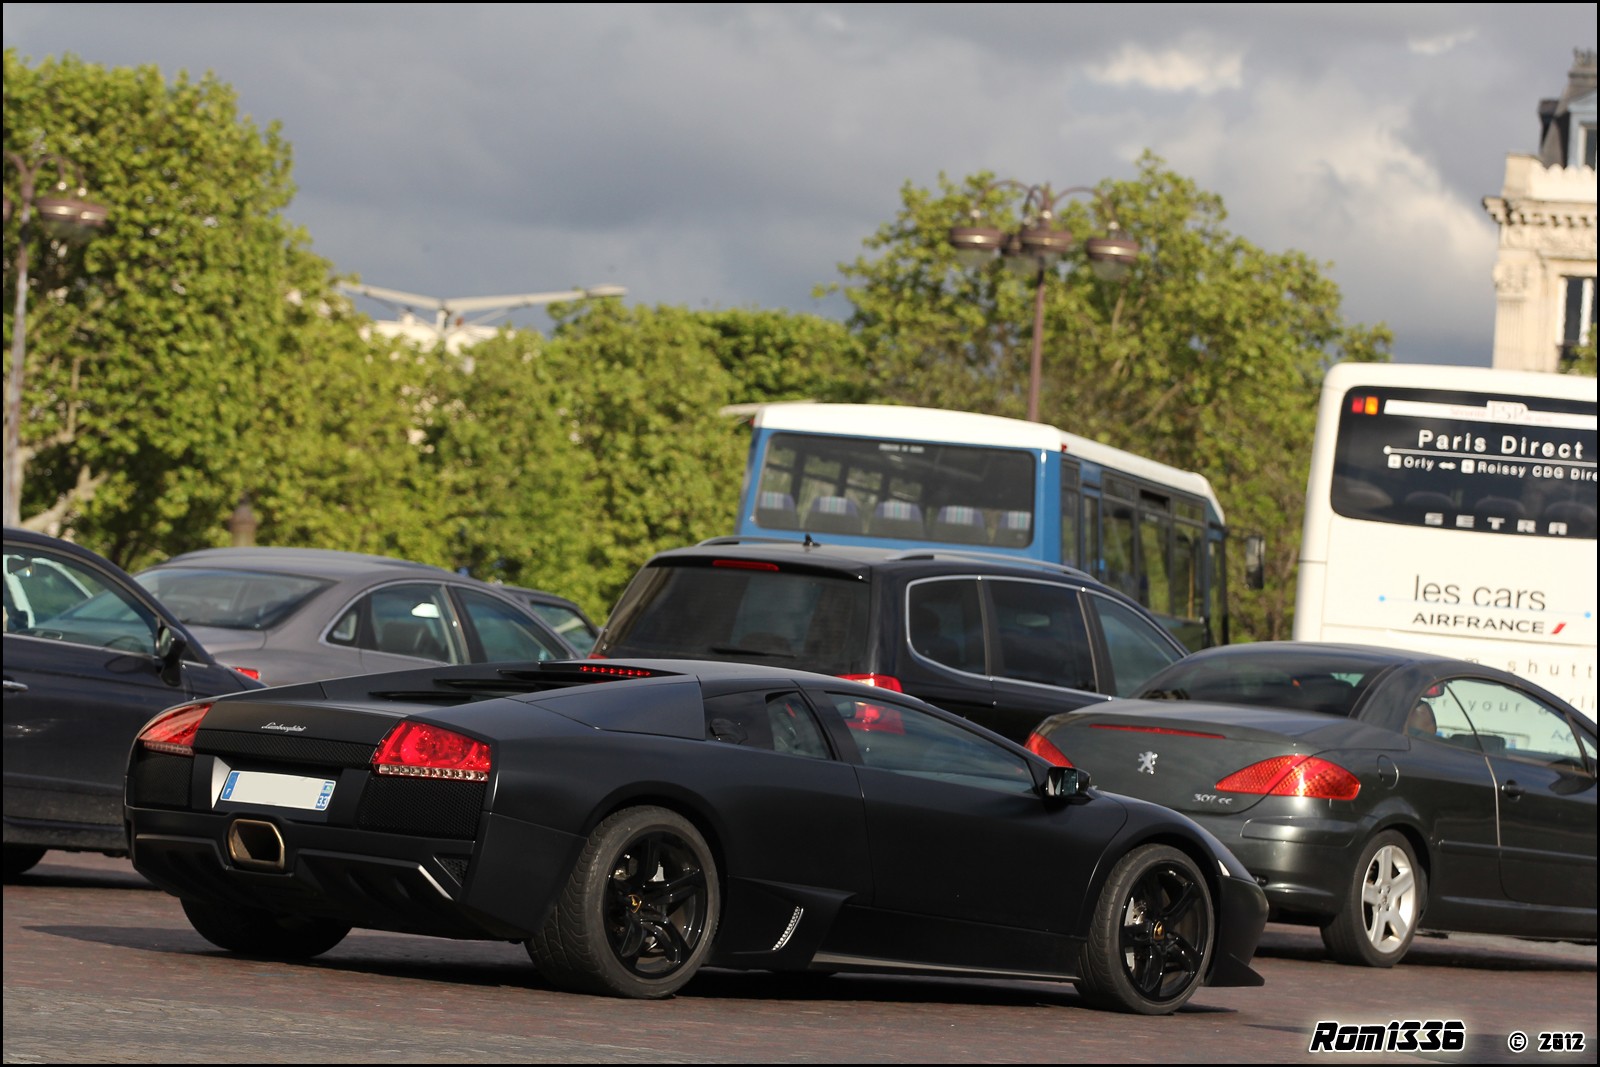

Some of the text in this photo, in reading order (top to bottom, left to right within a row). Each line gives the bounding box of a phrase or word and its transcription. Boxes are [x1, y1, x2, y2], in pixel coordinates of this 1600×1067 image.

[1418, 429, 1584, 460] Paris Direct
[1403, 455, 1434, 472] Orly
[1532, 465, 1565, 480] CDG
[1424, 512, 1568, 536] SETRA
[1414, 574, 1546, 612] les cars
[1412, 612, 1545, 635] AIRFRANCE
[1468, 700, 1522, 713] your
[1193, 793, 1217, 803] 307
